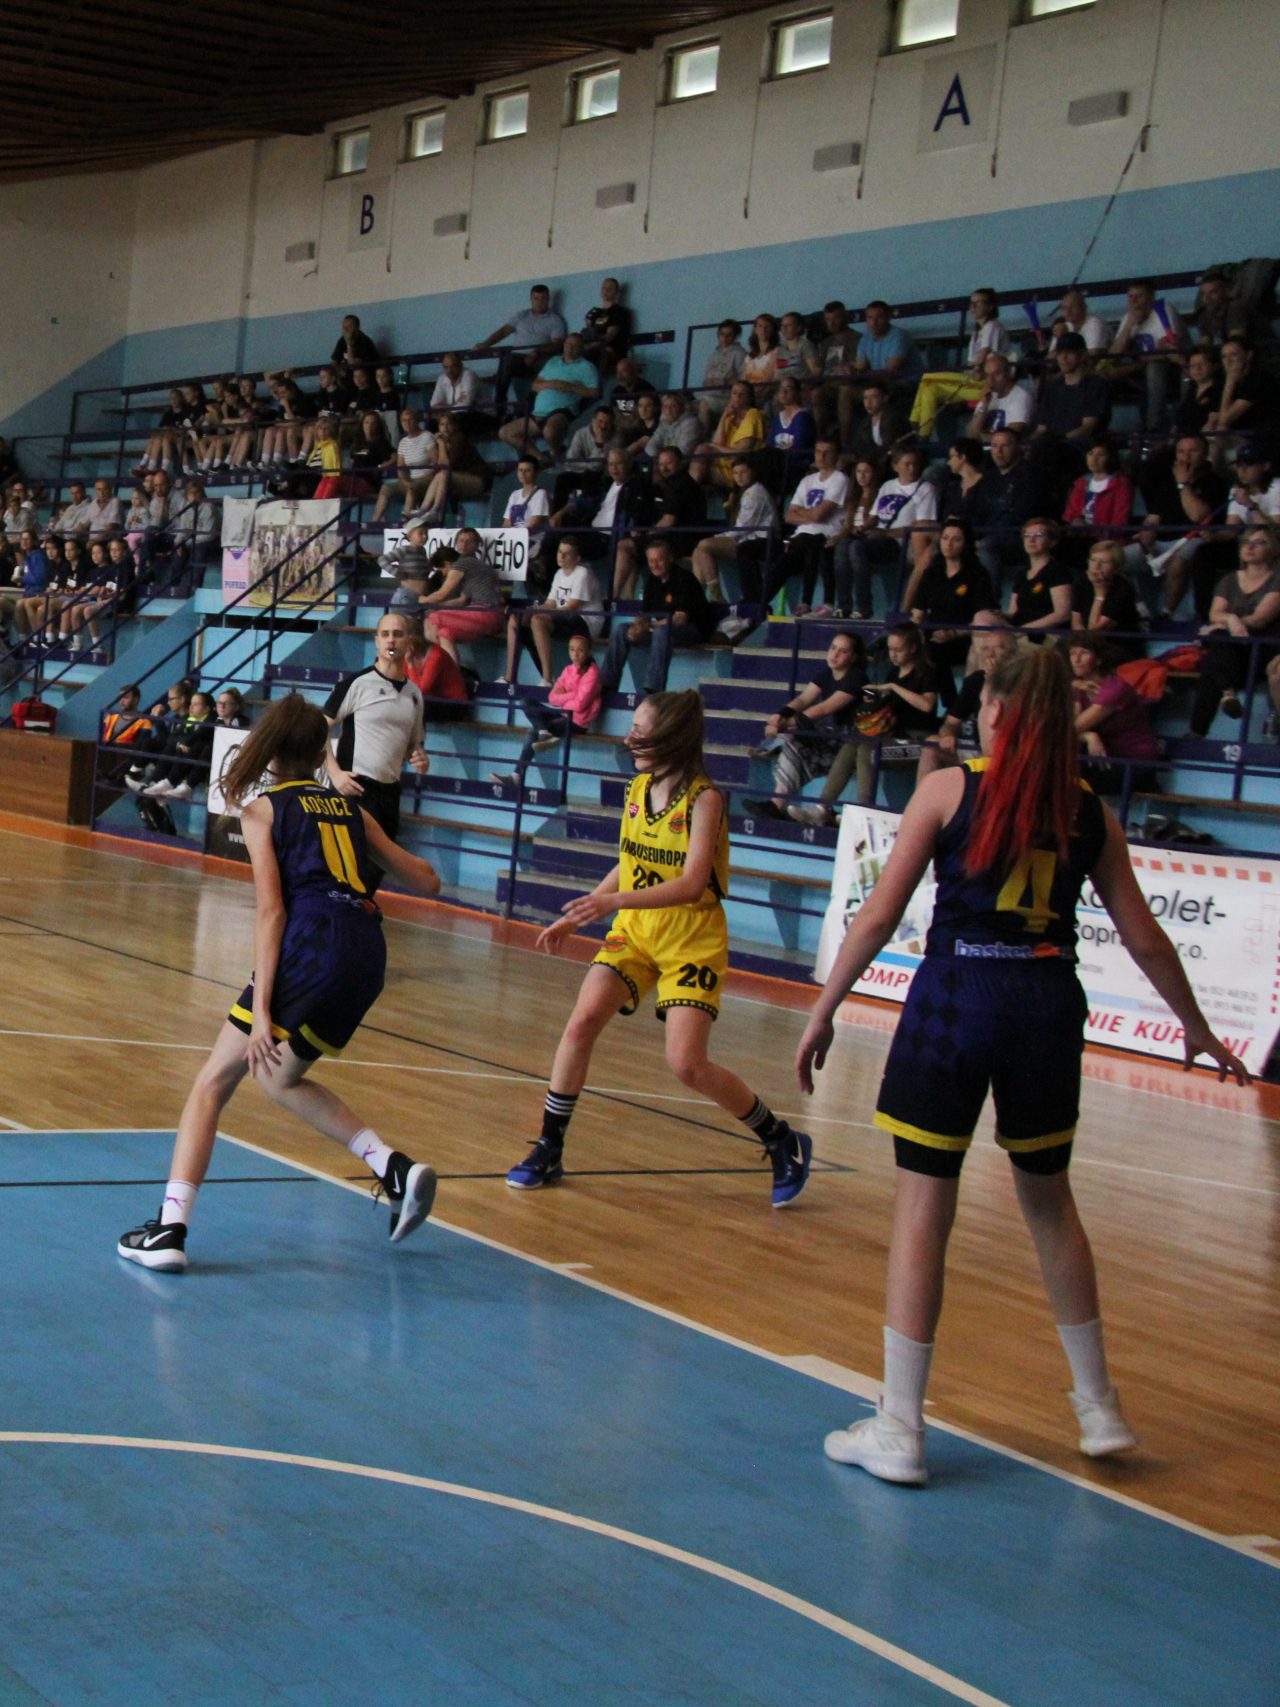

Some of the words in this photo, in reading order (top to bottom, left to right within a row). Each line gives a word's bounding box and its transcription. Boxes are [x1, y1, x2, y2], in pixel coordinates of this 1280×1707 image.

[933, 73, 970, 131] A
[360, 195, 375, 235] B
[1222, 744, 1241, 762] 19
[298, 795, 353, 816] KOŠICE
[743, 819, 754, 834] 13
[802, 828, 814, 842] 14
[317, 821, 367, 894] 11
[995, 850, 1060, 933] 4
[677, 963, 718, 991] 20
